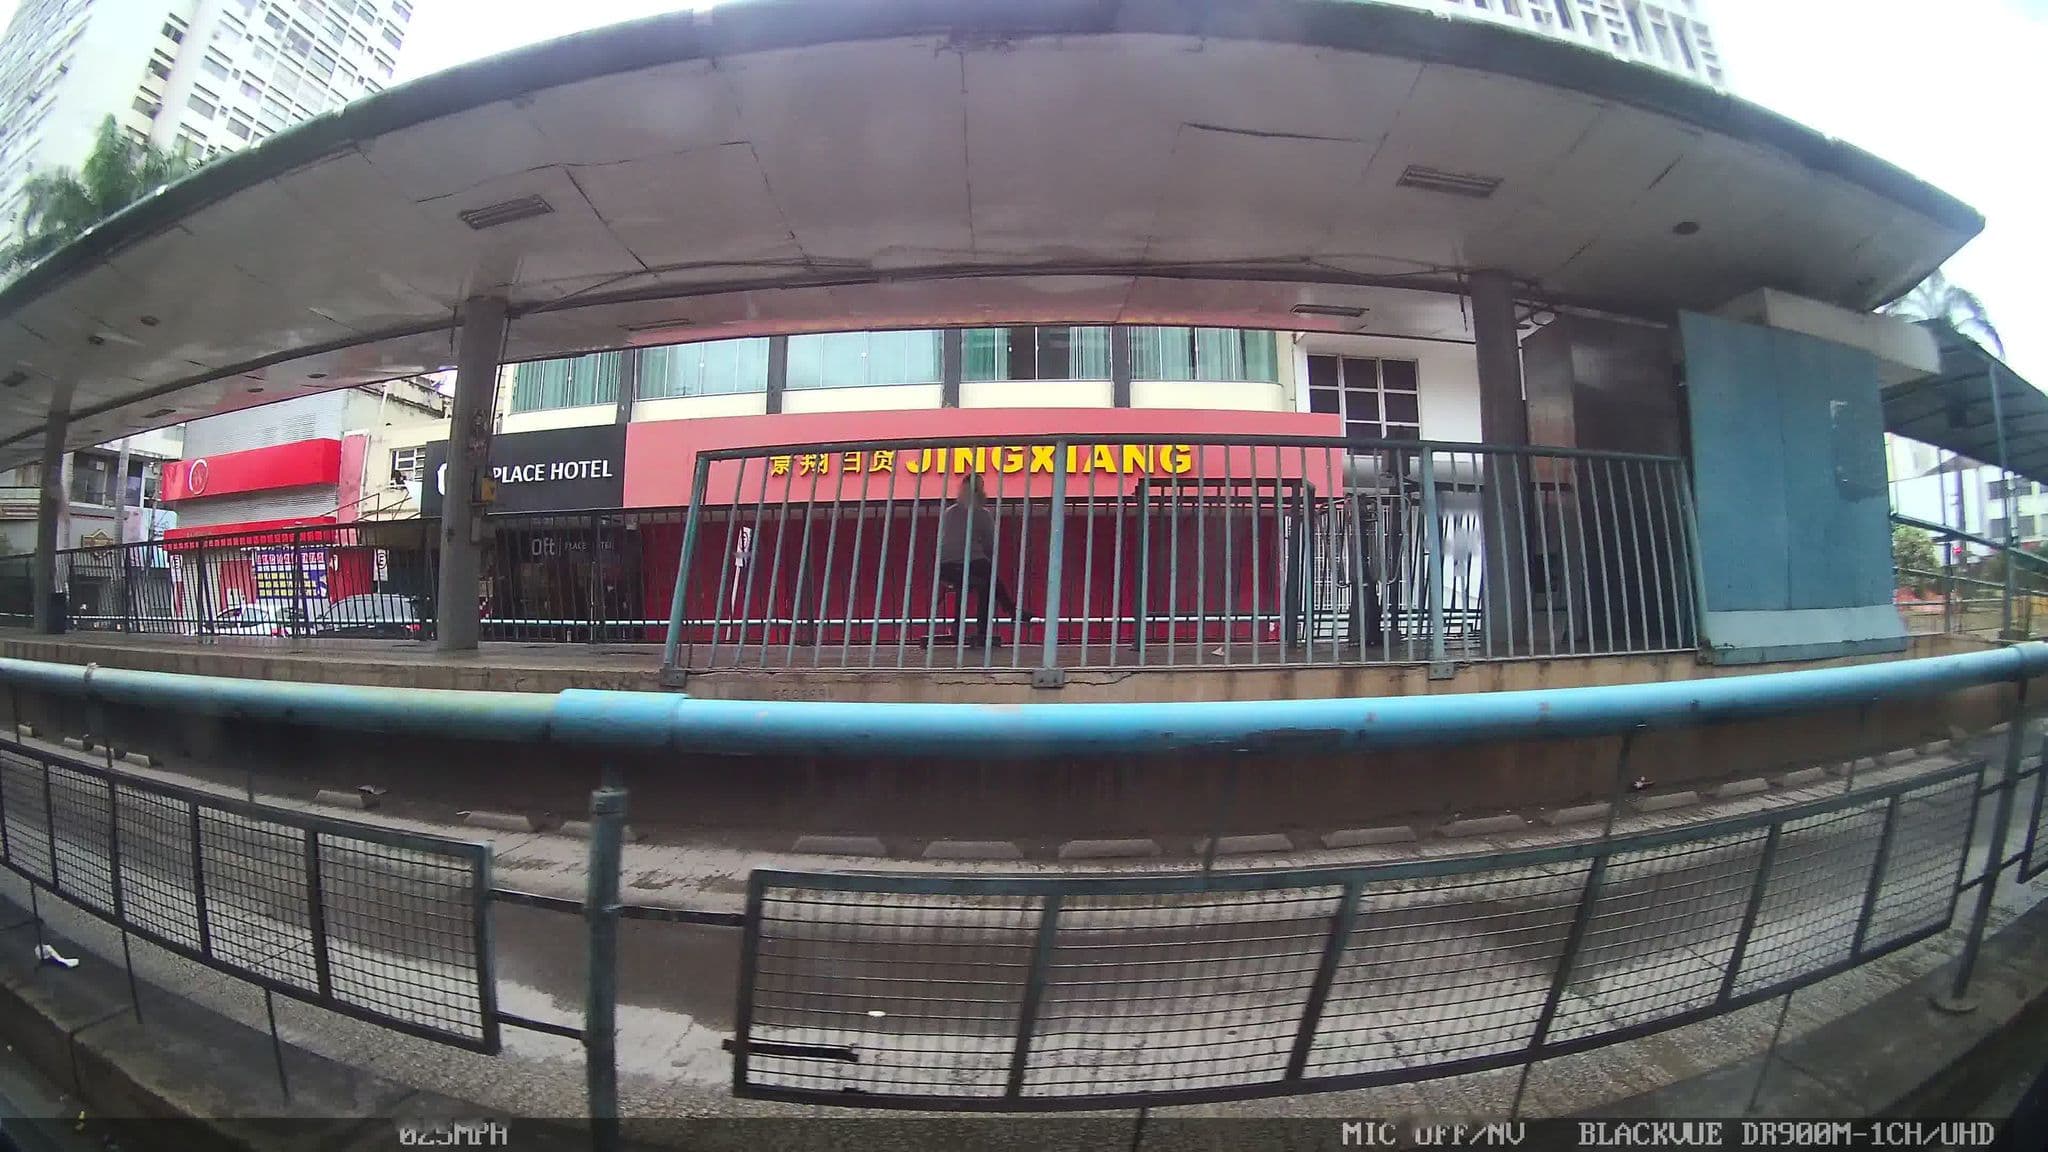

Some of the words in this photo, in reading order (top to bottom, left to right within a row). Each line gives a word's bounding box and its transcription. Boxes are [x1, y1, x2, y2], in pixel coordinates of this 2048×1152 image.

[493, 463, 545, 483] PLACE
[550, 459, 612, 480] HOTEL
[905, 445, 1192, 474] JINGXIANG
